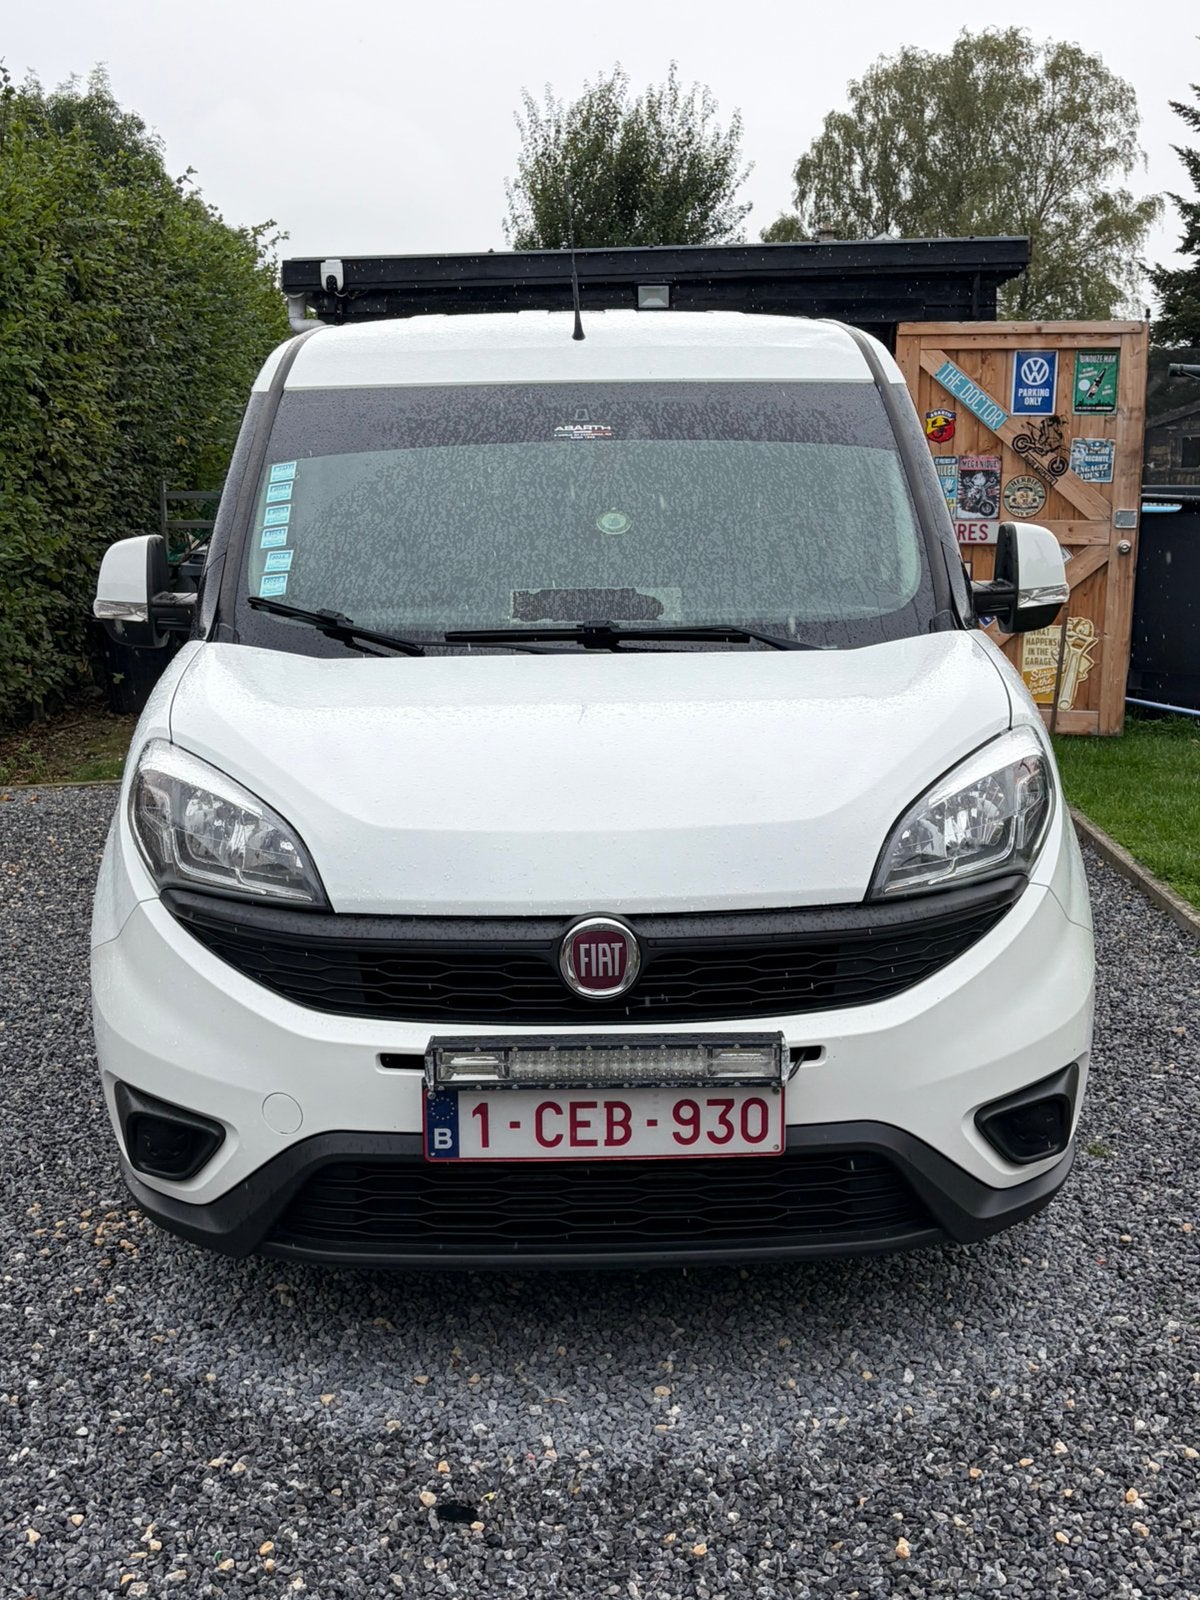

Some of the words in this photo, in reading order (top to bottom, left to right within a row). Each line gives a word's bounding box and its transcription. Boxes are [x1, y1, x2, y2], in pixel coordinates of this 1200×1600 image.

[941, 364, 965, 391] THE
[960, 383, 1004, 427] DOCTOR
[1018, 388, 1050, 397] PARKING
[1024, 397, 1043, 405] ONLY
[954, 523, 988, 541] RES
[1026, 638, 1057, 646] HAPPENS
[1025, 657, 1052, 665] GARAGE
[579, 942, 623, 977] FIAT
[471, 1096, 769, 1149] 1-CEB-930
[434, 1128, 453, 1150] B
